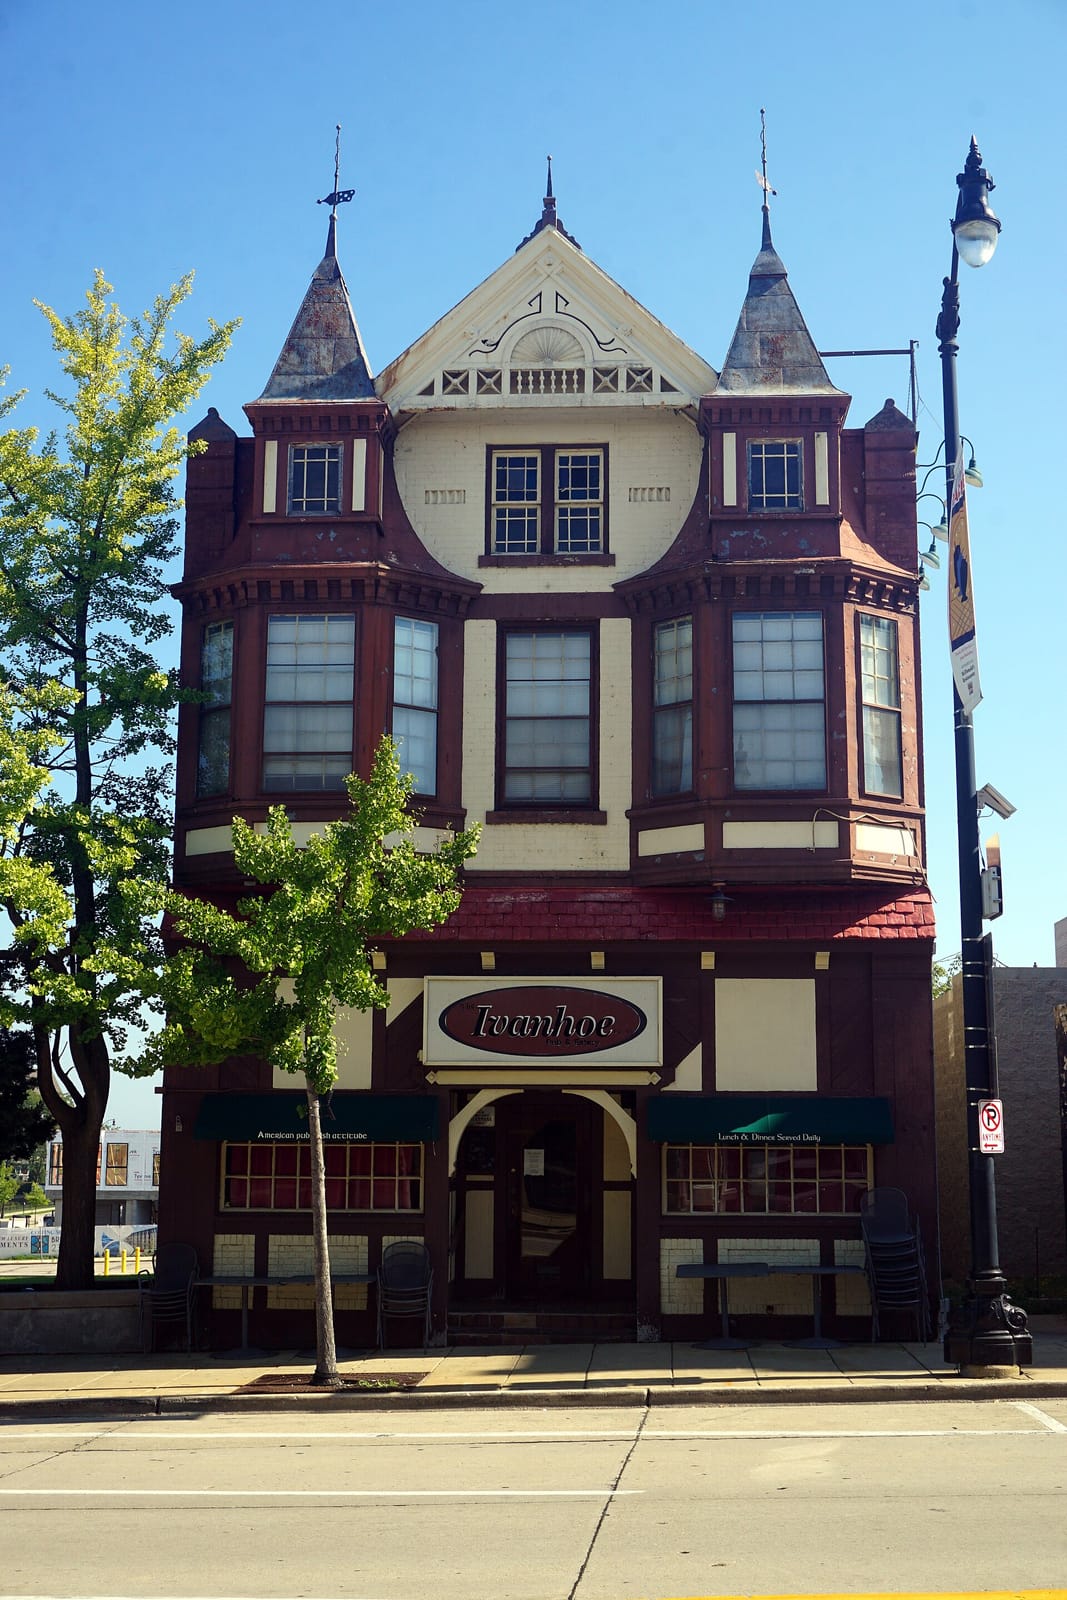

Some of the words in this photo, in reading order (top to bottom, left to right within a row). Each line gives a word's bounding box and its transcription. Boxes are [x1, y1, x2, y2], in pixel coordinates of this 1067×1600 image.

[470, 1004, 616, 1039] Ivanhoe
[257, 1131, 295, 1139] American
[296, 1132, 310, 1140] pub
[332, 1131, 367, 1139] attitude
[718, 1132, 739, 1140] Lunch
[751, 1133, 775, 1141] Dinner
[776, 1133, 801, 1141] Served
[802, 1133, 821, 1142] Daily
